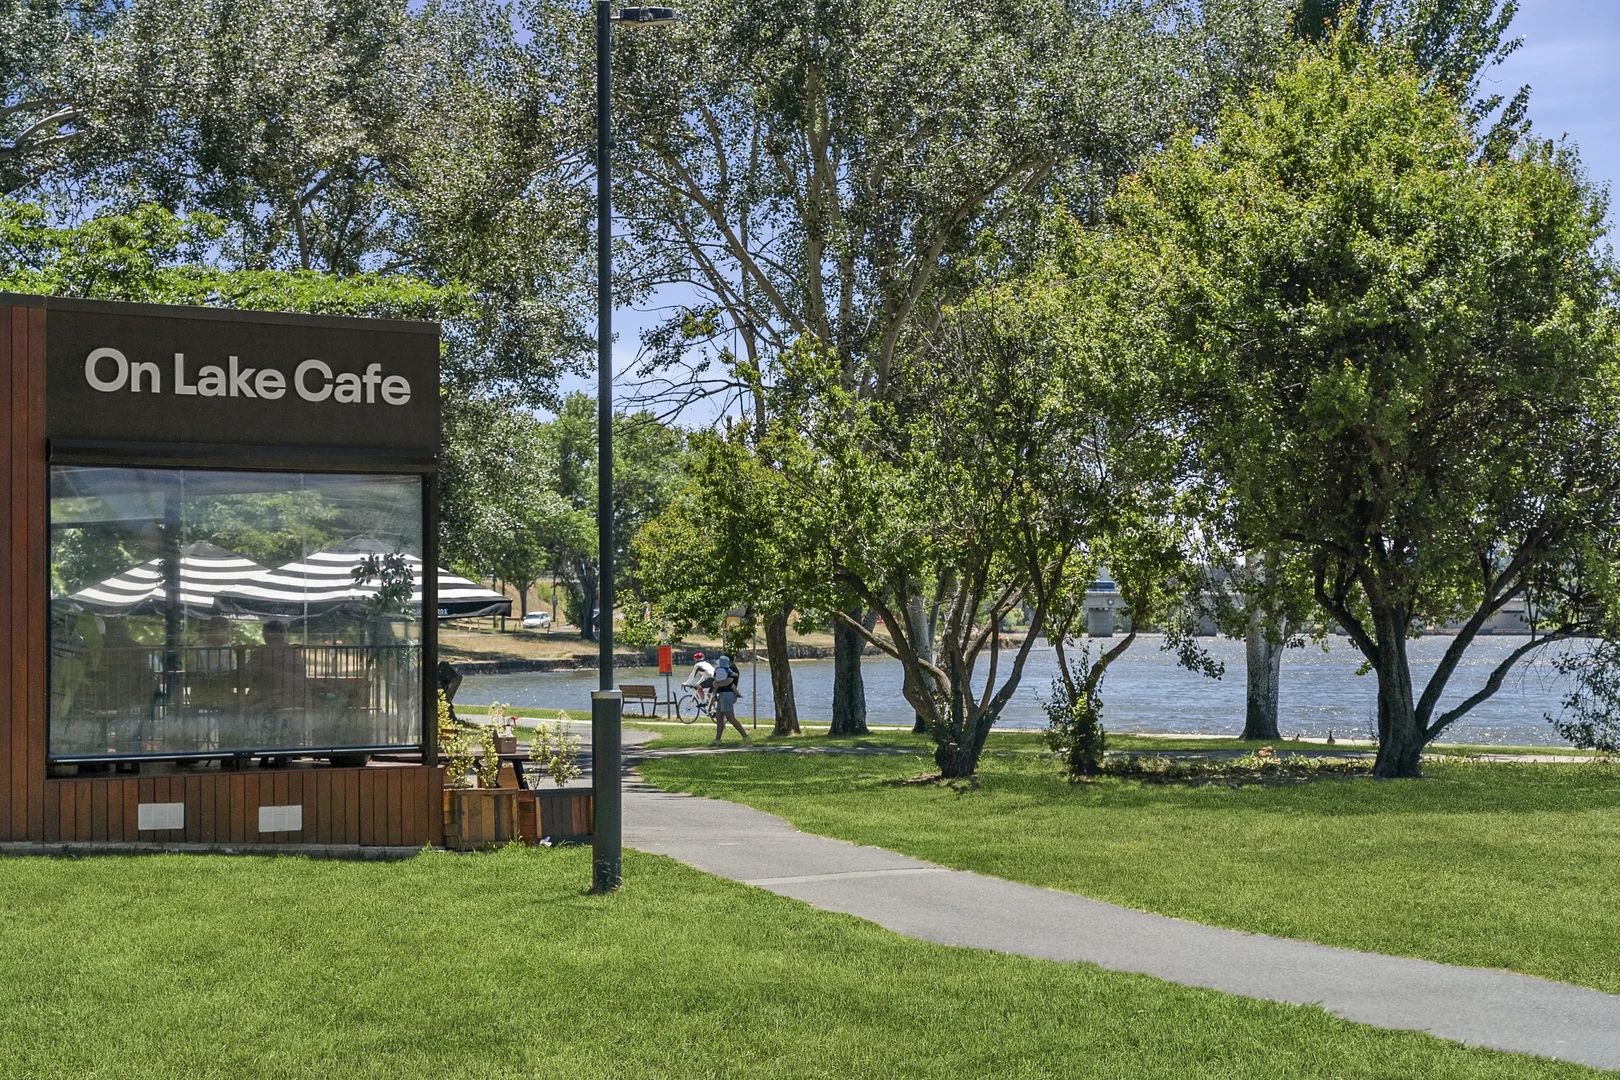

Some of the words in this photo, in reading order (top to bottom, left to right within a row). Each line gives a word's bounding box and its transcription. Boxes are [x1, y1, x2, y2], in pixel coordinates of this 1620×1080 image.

[85, 347, 161, 394] On
[174, 352, 287, 400] Lake
[294, 359, 412, 406] Cafe
